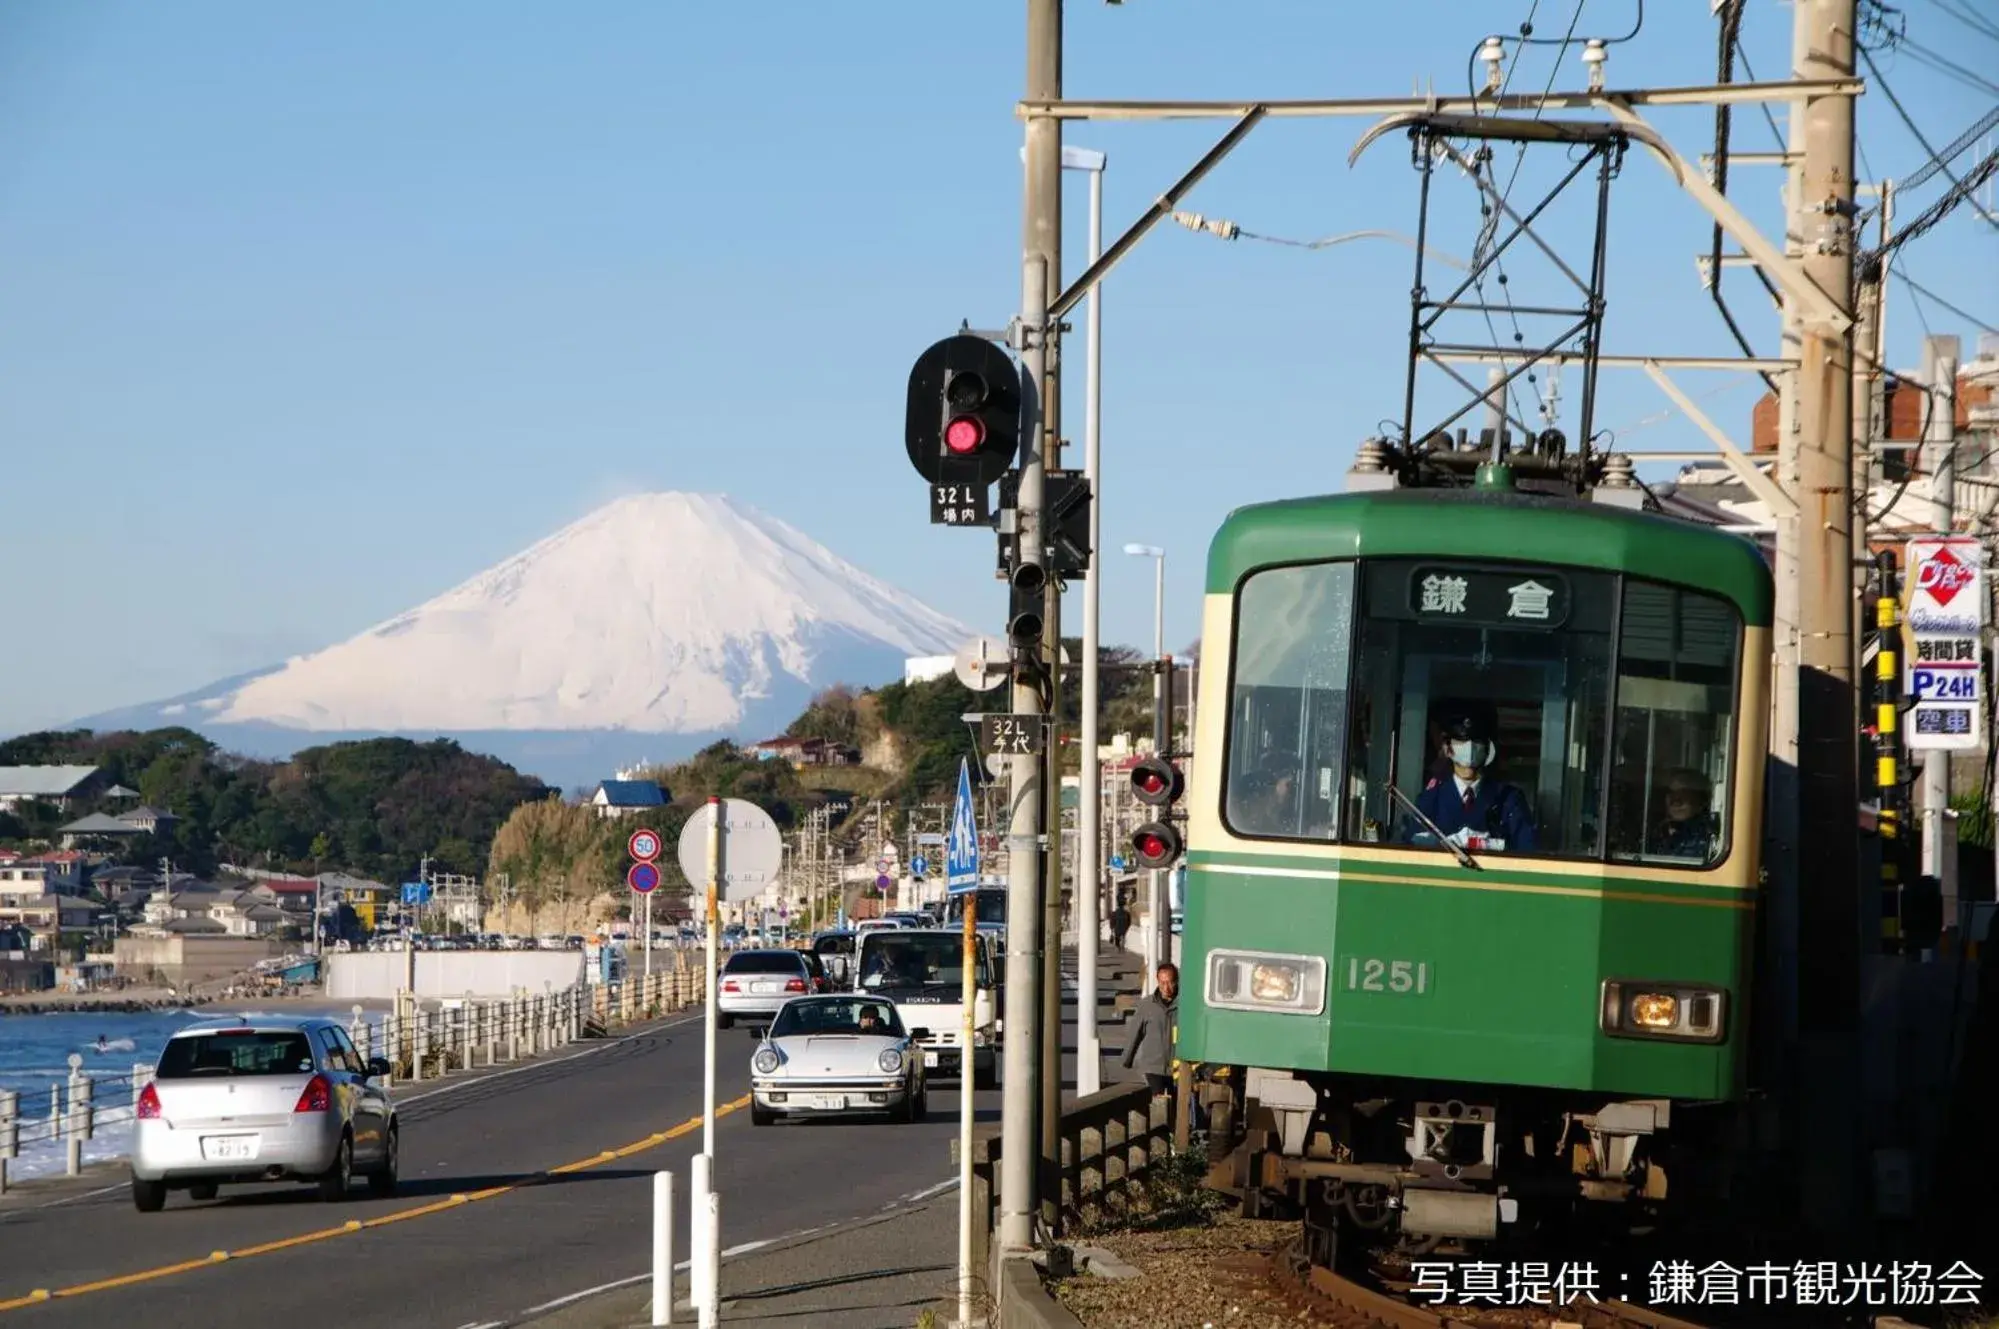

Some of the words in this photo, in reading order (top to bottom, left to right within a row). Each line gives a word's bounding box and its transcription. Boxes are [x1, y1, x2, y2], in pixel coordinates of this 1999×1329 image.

[938, 487, 957, 504] 32
[965, 487, 975, 503] L
[943, 507, 975, 522] 場内
[1420, 573, 1555, 619] 鎌倉
[1914, 671, 1934, 697] P
[1936, 677, 1974, 697] 24H
[636, 838, 653, 853] 50
[1347, 957, 1427, 995] 1251
